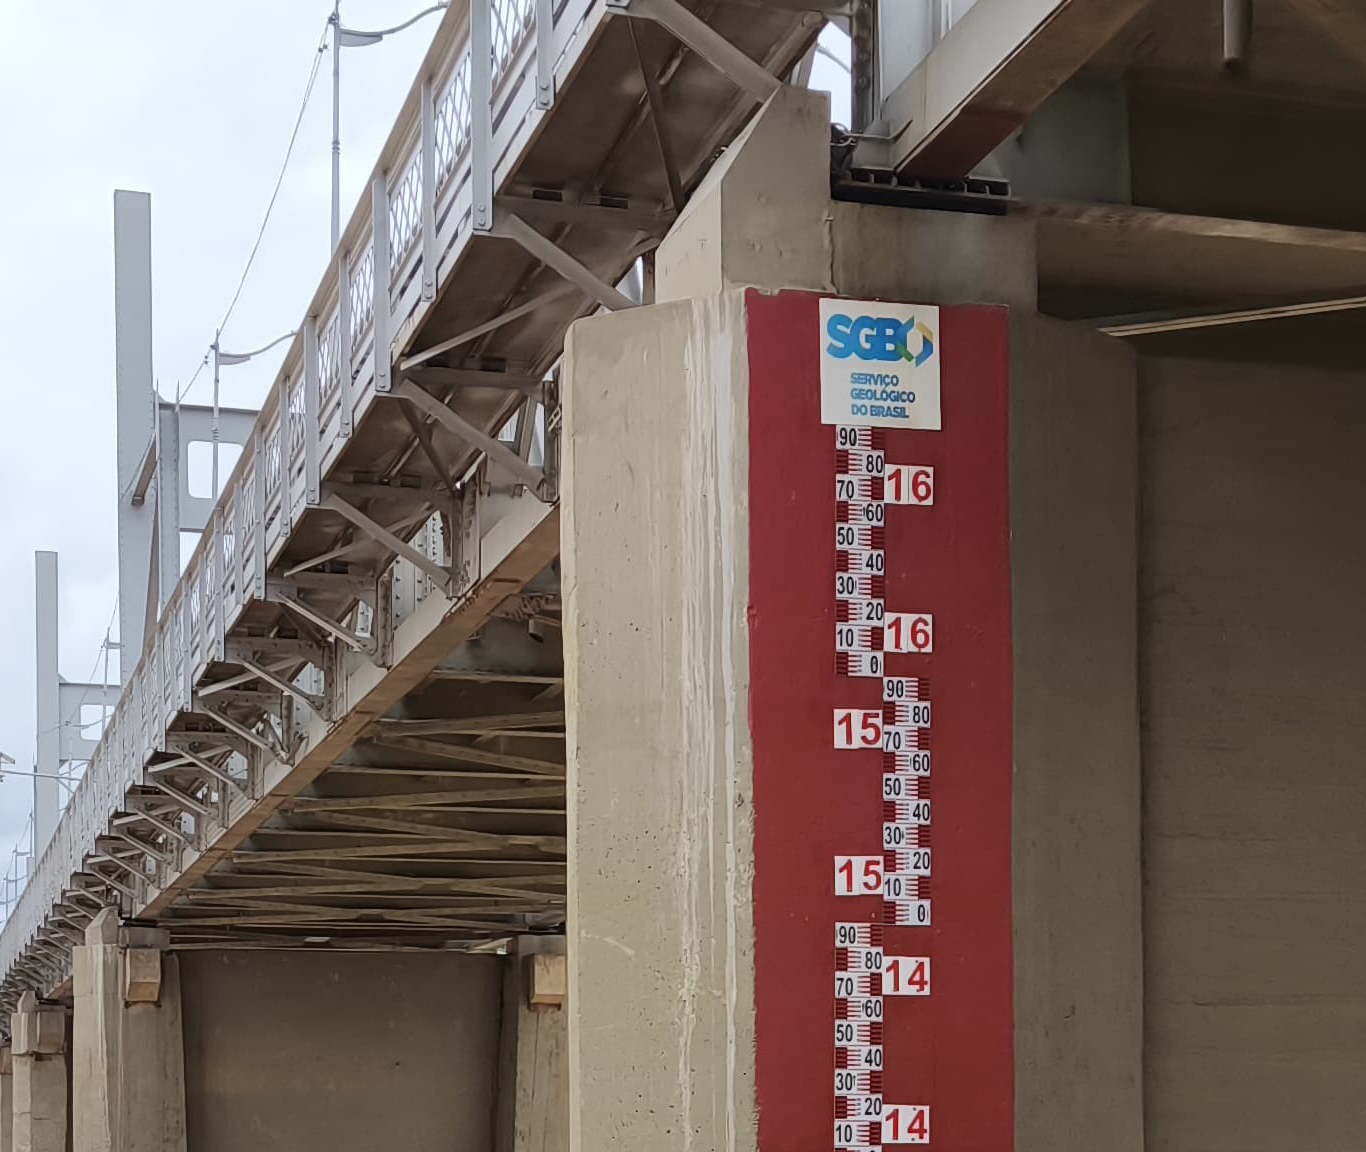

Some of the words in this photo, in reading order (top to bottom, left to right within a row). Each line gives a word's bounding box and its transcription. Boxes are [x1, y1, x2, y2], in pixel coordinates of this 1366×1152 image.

[826, 313, 905, 361] SGB
[850, 372, 900, 388] SERVIÇO
[850, 386, 916, 403] GEOLÓGICO
[851, 404, 868, 416] DO
[870, 405, 910, 419] BRASIL
[839, 428, 857, 447] 90
[866, 455, 883, 473] 80
[837, 481, 854, 499] 70
[887, 469, 932, 503] 16
[866, 504, 883, 522] 60
[837, 527, 855, 545] 50
[865, 553, 883, 571] 40
[837, 576, 854, 594] 30
[866, 603, 883, 621] 20
[837, 629, 854, 647] 10
[887, 617, 931, 650] 16
[870, 656, 879, 674] 0
[886, 680, 904, 698] 90
[912, 706, 930, 725] 80
[837, 713, 881, 745] 15
[884, 732, 901, 750] 70
[912, 754, 930, 772] 60
[884, 778, 901, 797] 50
[912, 804, 930, 822] 40
[884, 827, 901, 845] 30
[913, 852, 930, 870] 20
[839, 860, 881, 892] 15
[884, 878, 901, 897] 10
[917, 905, 926, 923] 0
[838, 926, 856, 945] 90
[865, 951, 882, 970] 80
[885, 962, 928, 992] 14
[837, 978, 853, 996] 70
[865, 1000, 882, 1018] 60
[836, 1024, 853, 1042] 50
[865, 1048, 882, 1067] 40
[836, 1072, 853, 1091] 30
[865, 1098, 882, 1116] 20
[836, 1124, 853, 1143] 10
[885, 1110, 927, 1141] 14
